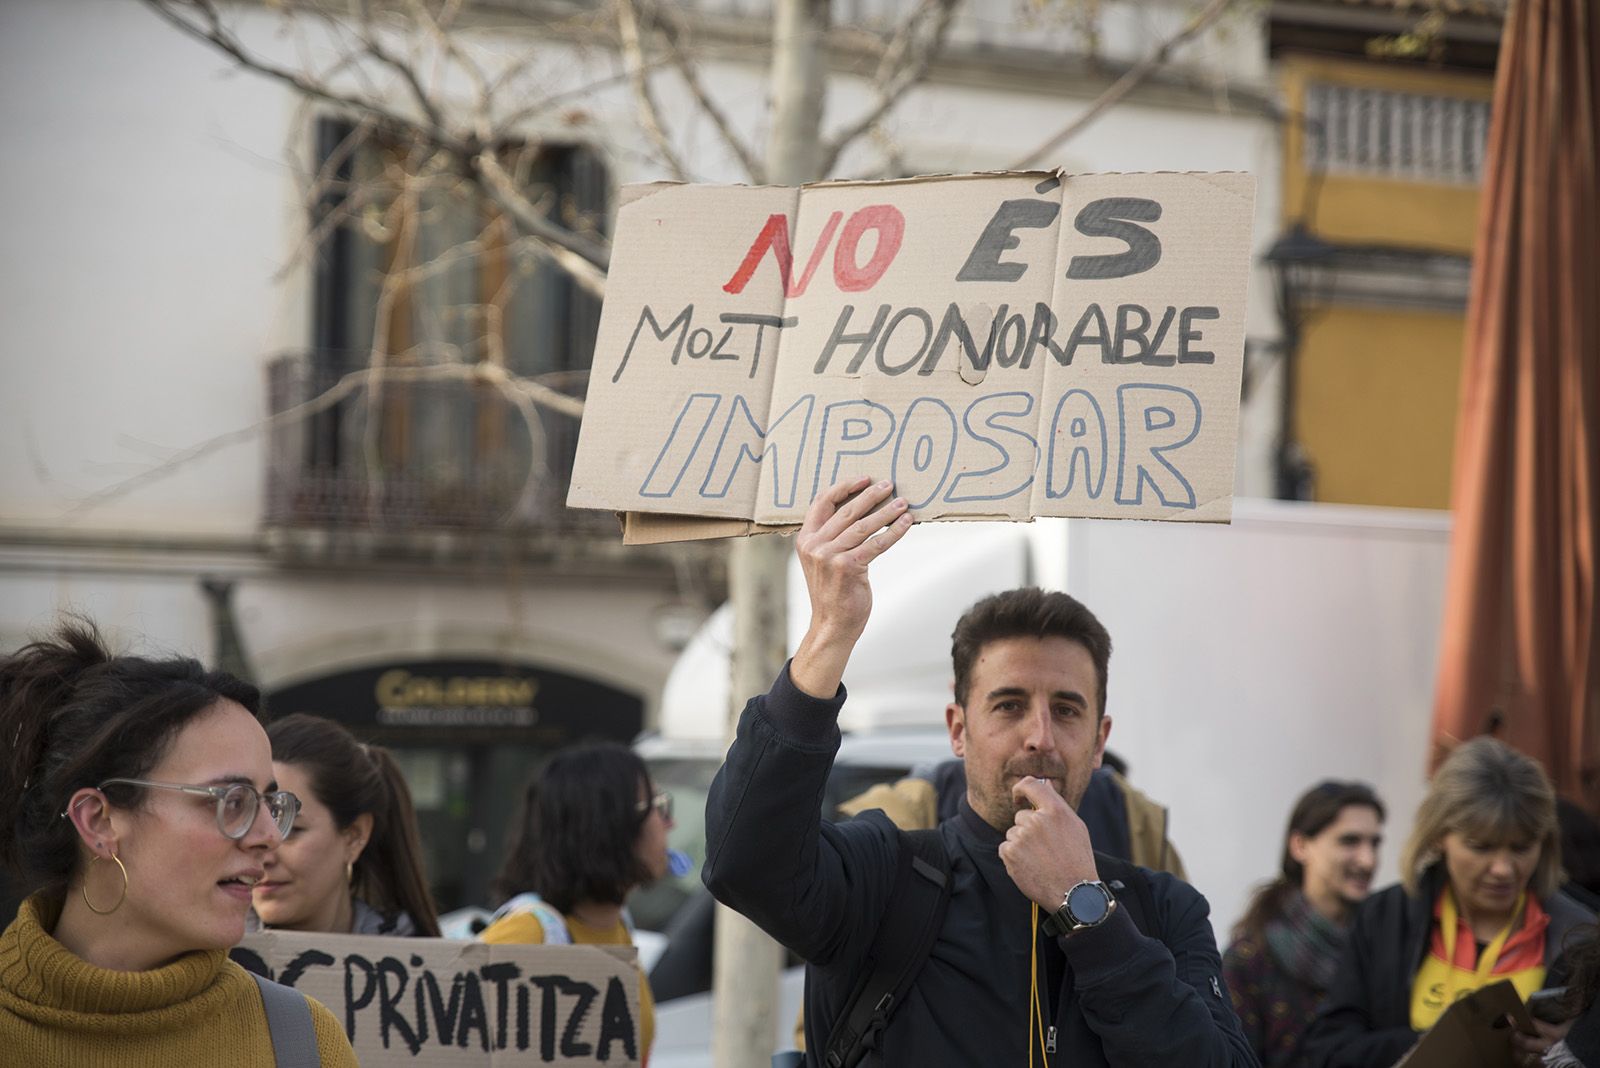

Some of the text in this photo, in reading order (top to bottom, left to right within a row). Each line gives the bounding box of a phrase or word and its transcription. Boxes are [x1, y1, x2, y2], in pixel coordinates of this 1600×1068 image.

[722, 178, 1163, 298] NO ÉS
[612, 301, 1220, 383] MOLT HONORABLE
[638, 382, 1202, 510] IMPOSAR
